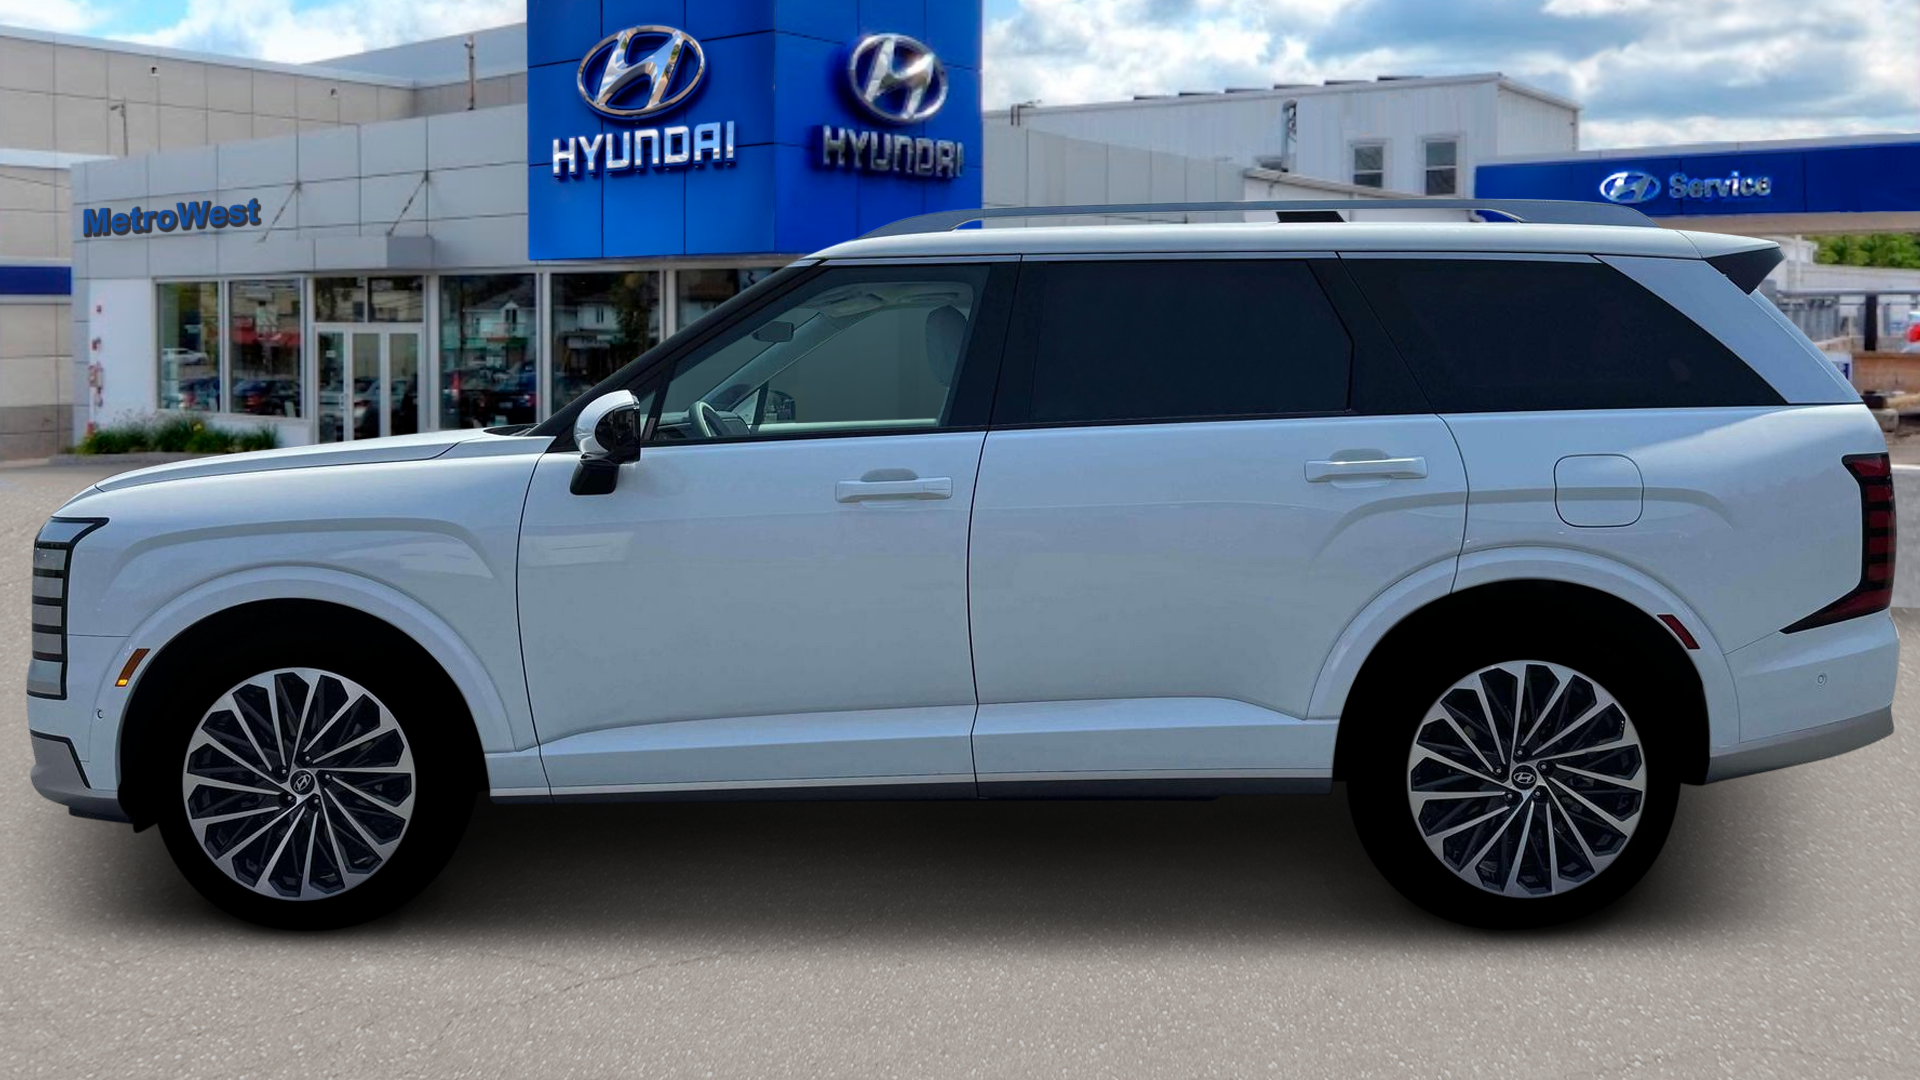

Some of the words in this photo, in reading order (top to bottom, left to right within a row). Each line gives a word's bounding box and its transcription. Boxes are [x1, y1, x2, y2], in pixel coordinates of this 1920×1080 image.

[552, 120, 735, 178] HYUNDAI
[823, 125, 963, 178] HYUNDAI
[1669, 170, 1771, 198] Service
[83, 198, 261, 237] MetroWest
